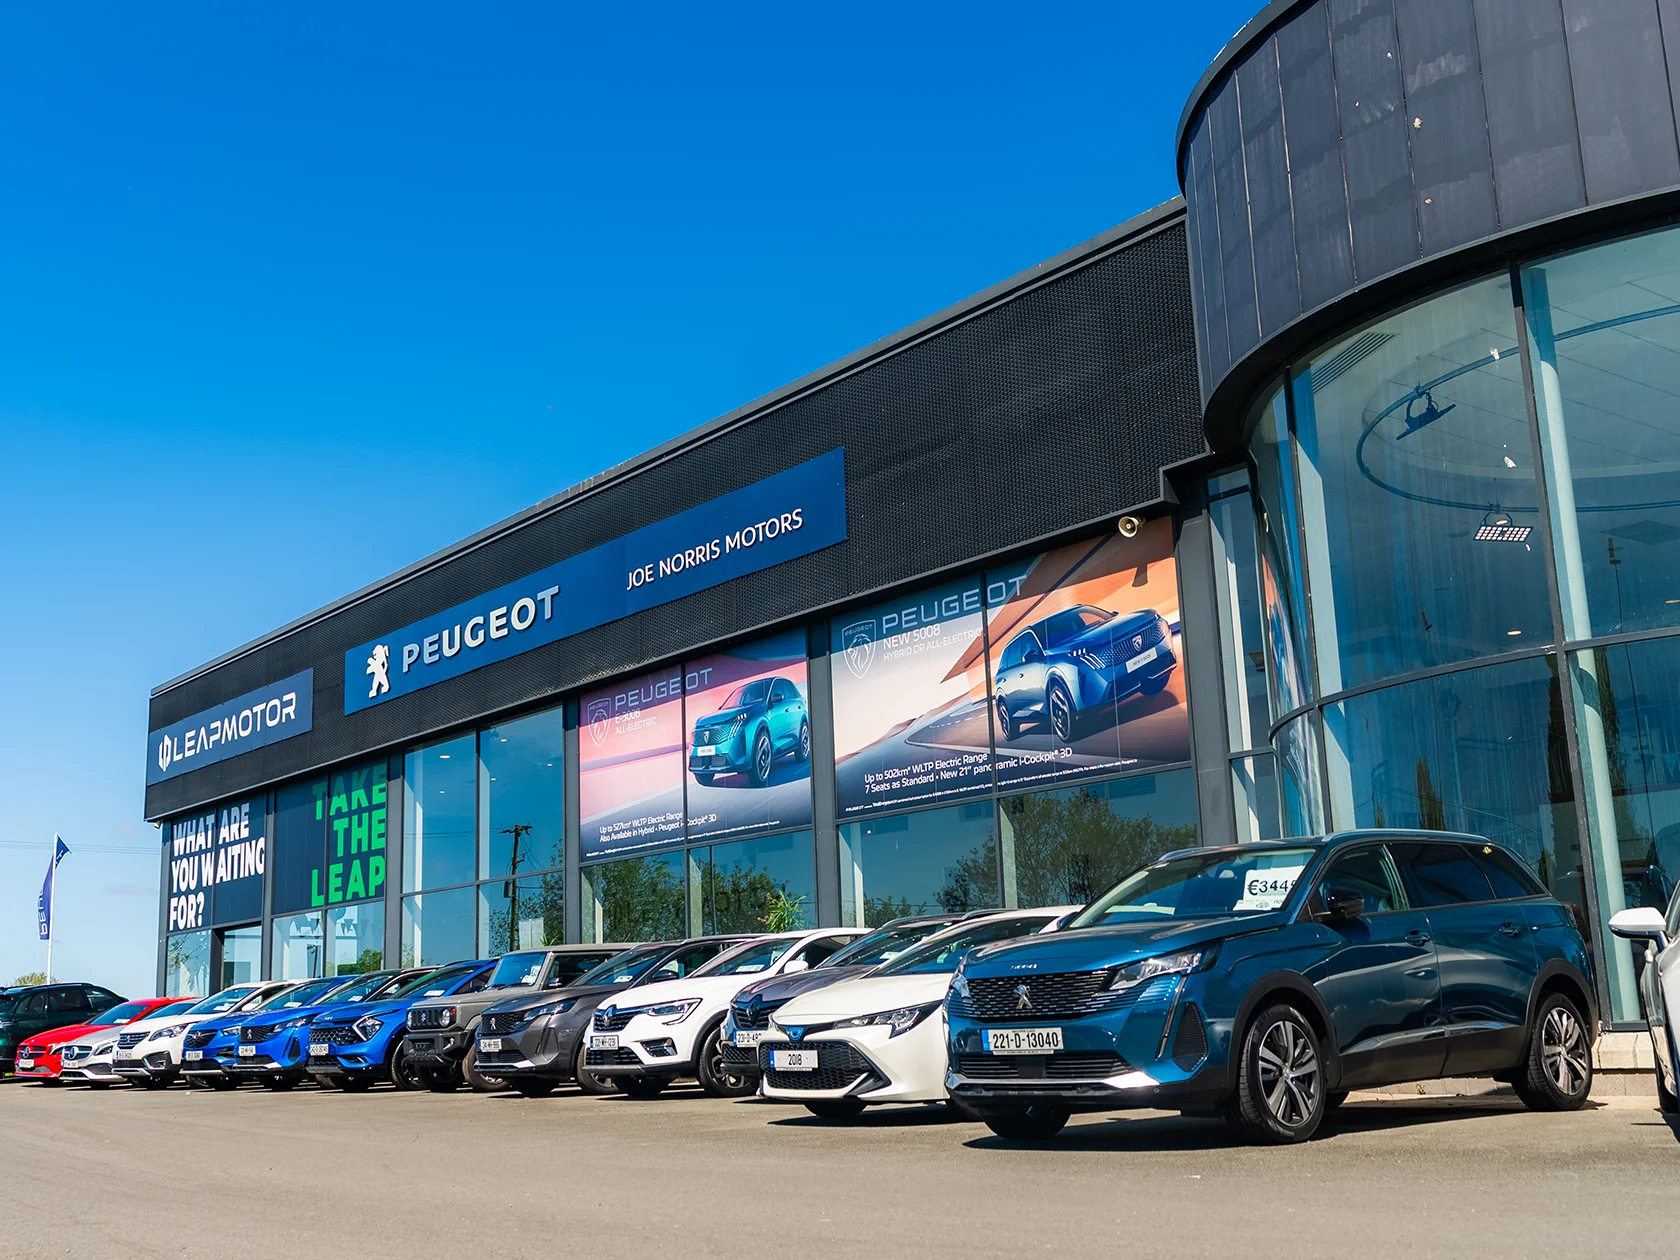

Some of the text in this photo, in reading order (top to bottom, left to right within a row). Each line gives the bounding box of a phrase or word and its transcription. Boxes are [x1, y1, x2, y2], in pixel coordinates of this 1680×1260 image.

[626, 508, 803, 591] JOE NORRIS MOTORS
[882, 575, 1027, 634] PEUGEOT
[402, 585, 560, 673] PEUGEOT
[883, 624, 941, 650] NEW 5008
[883, 628, 982, 662] HYBRID OR ALL-ELECTRIC
[615, 668, 713, 711] PEUGEOT
[173, 691, 296, 762] LEAPMOTOR
[615, 716, 657, 736] ALL-ELECTRIC
[312, 762, 387, 820] TAKE
[864, 774, 874, 784] Up
[875, 772, 883, 781] to
[912, 762, 934, 774] WLTP
[935, 756, 962, 770] Electric
[963, 753, 988, 766] Range
[864, 784, 869, 794] 7
[870, 782, 891, 793] Seats
[892, 781, 901, 789] as
[901, 774, 934, 788] Standard
[940, 769, 958, 780] New
[1060, 747, 1073, 759] 3D
[173, 802, 250, 857] WHAT ARE
[333, 808, 387, 858] THE
[666, 811, 683, 823] Range
[171, 837, 265, 893] YOU WAITING
[311, 855, 386, 907] LEAP
[169, 891, 205, 931] FOR?
[788, 1053, 803, 1066] 2018
[992, 1031, 1059, 1049] 221-D-13040
